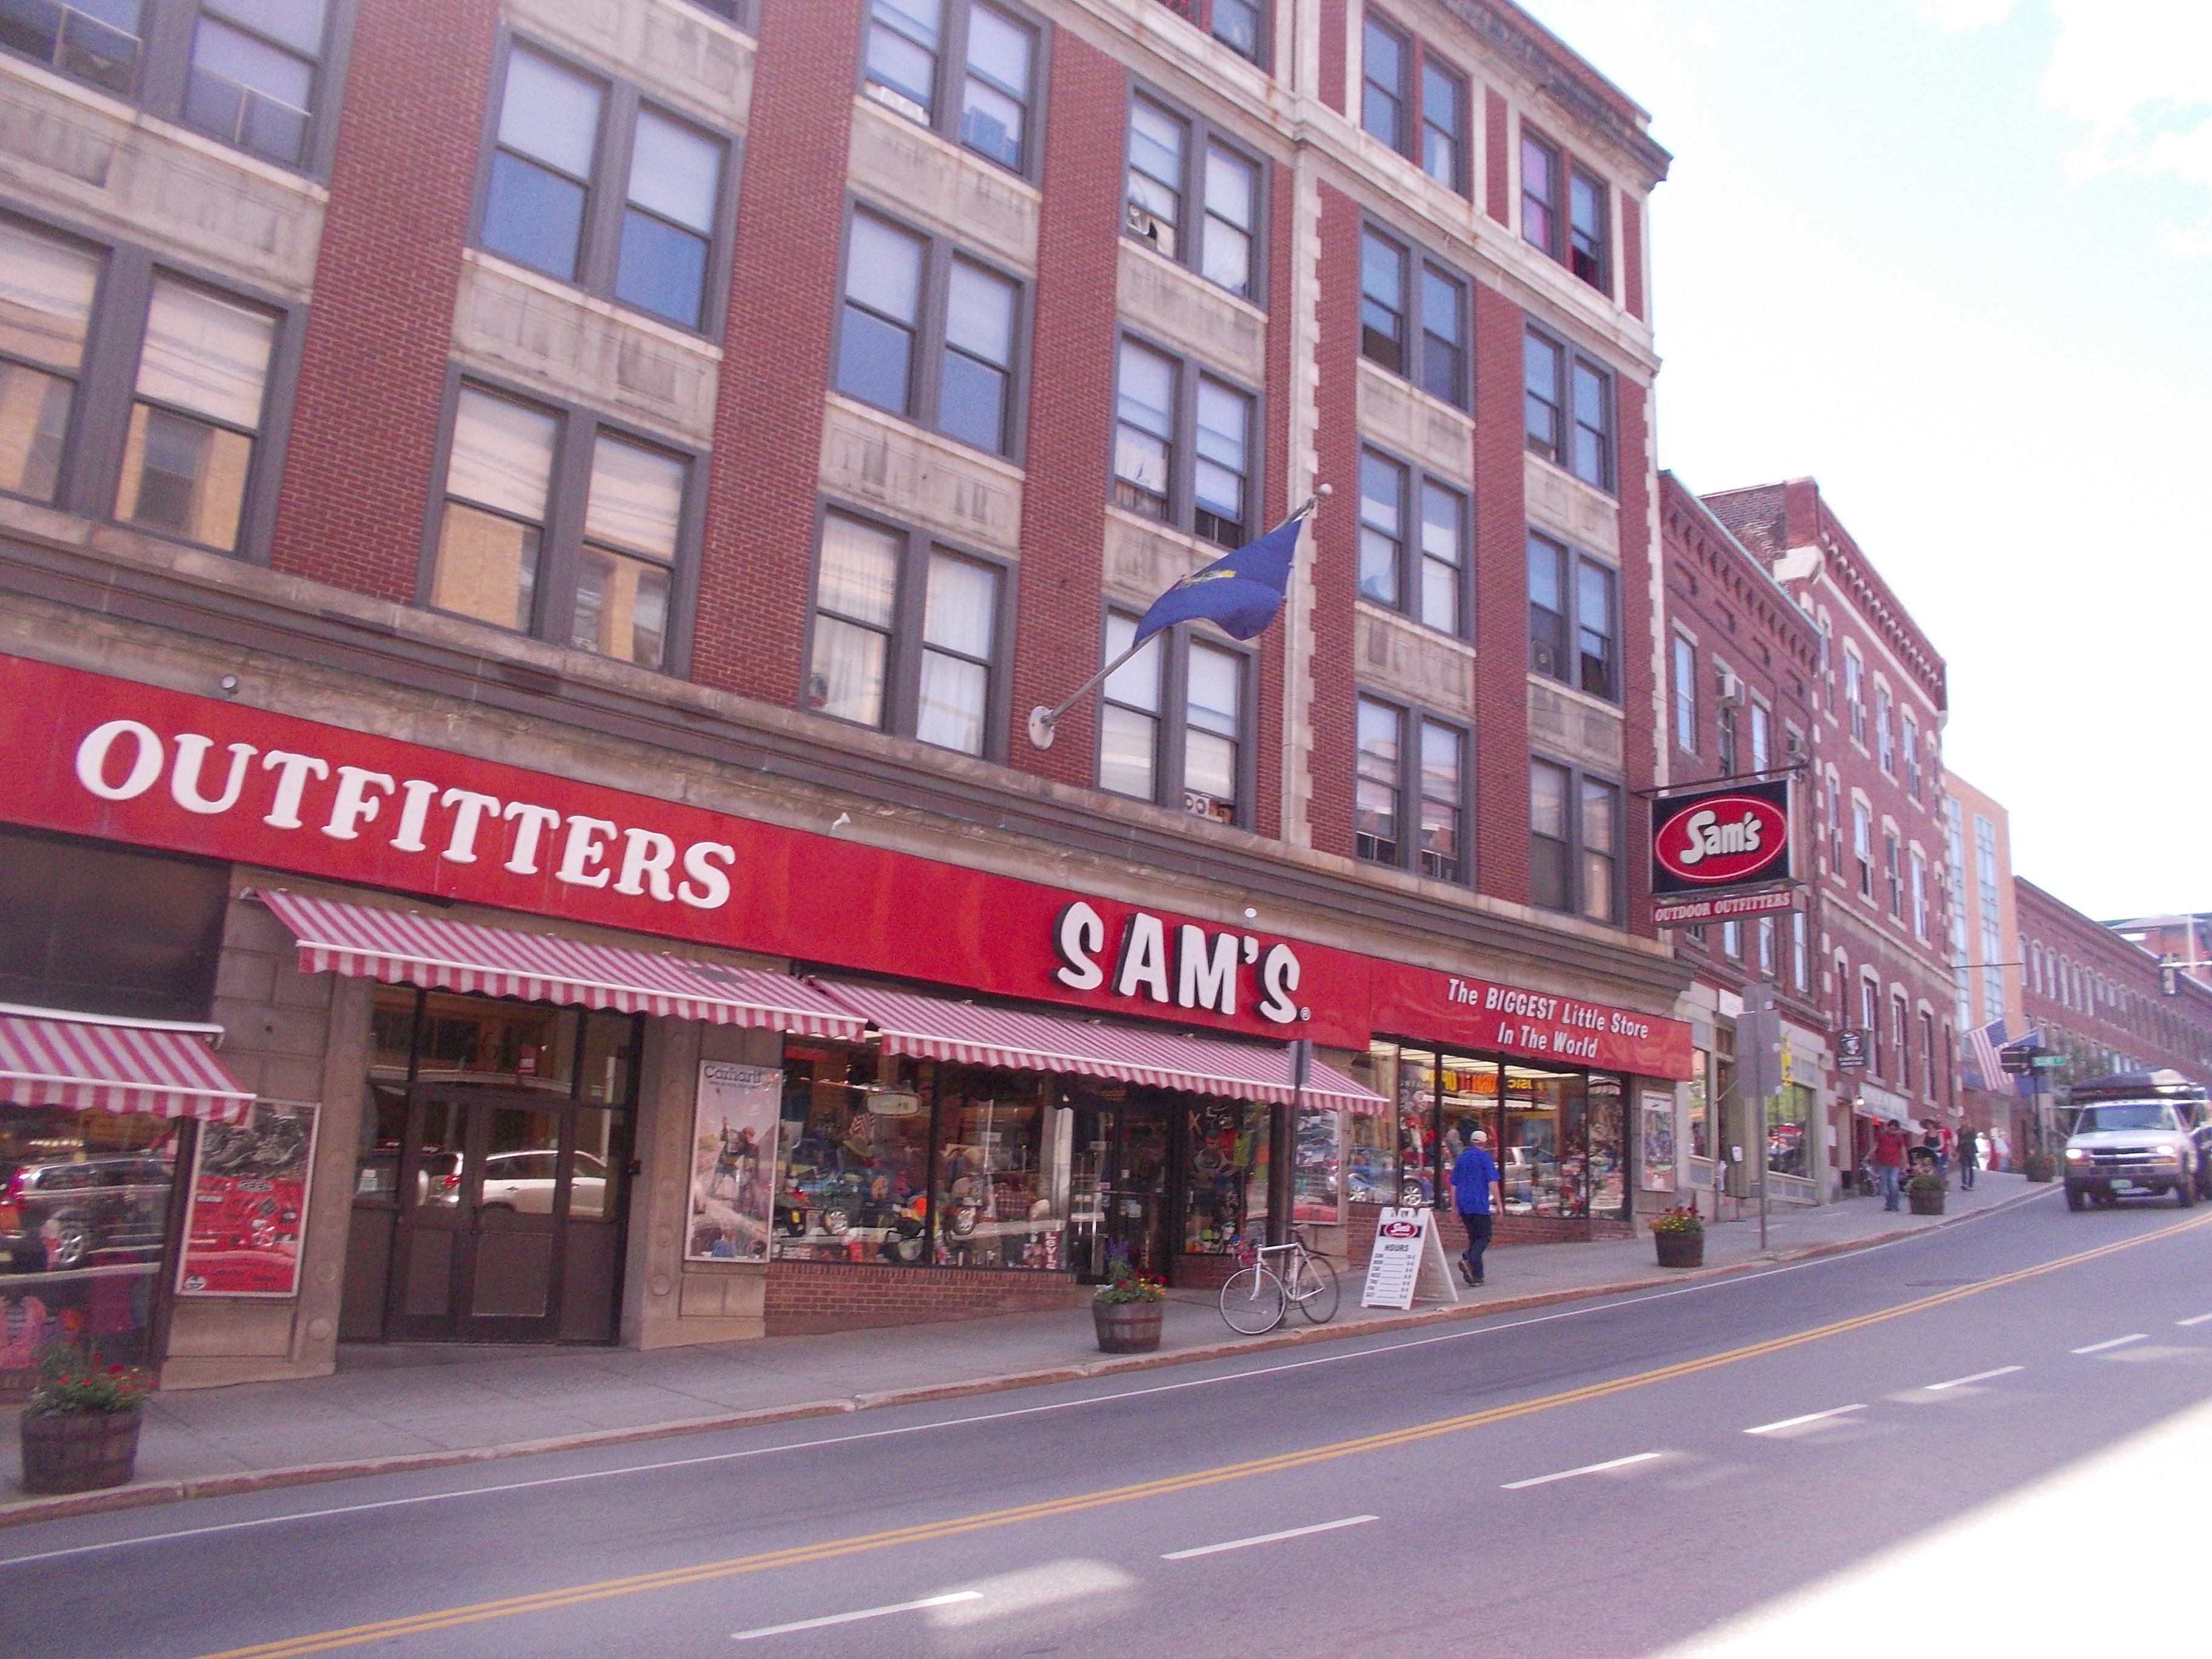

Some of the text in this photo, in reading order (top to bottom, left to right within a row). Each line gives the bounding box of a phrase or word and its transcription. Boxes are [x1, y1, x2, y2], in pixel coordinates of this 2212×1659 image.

[75, 719, 736, 910] OUTFITTERS
[1679, 809, 1763, 864] Sam's
[1655, 892, 1790, 922] OUTDOOR OUTFITTERS
[1052, 901, 1301, 1024] SAM'S
[1448, 979, 1649, 1039] The BIGGEST Little Store
[1496, 1022, 1598, 1058] In The World
